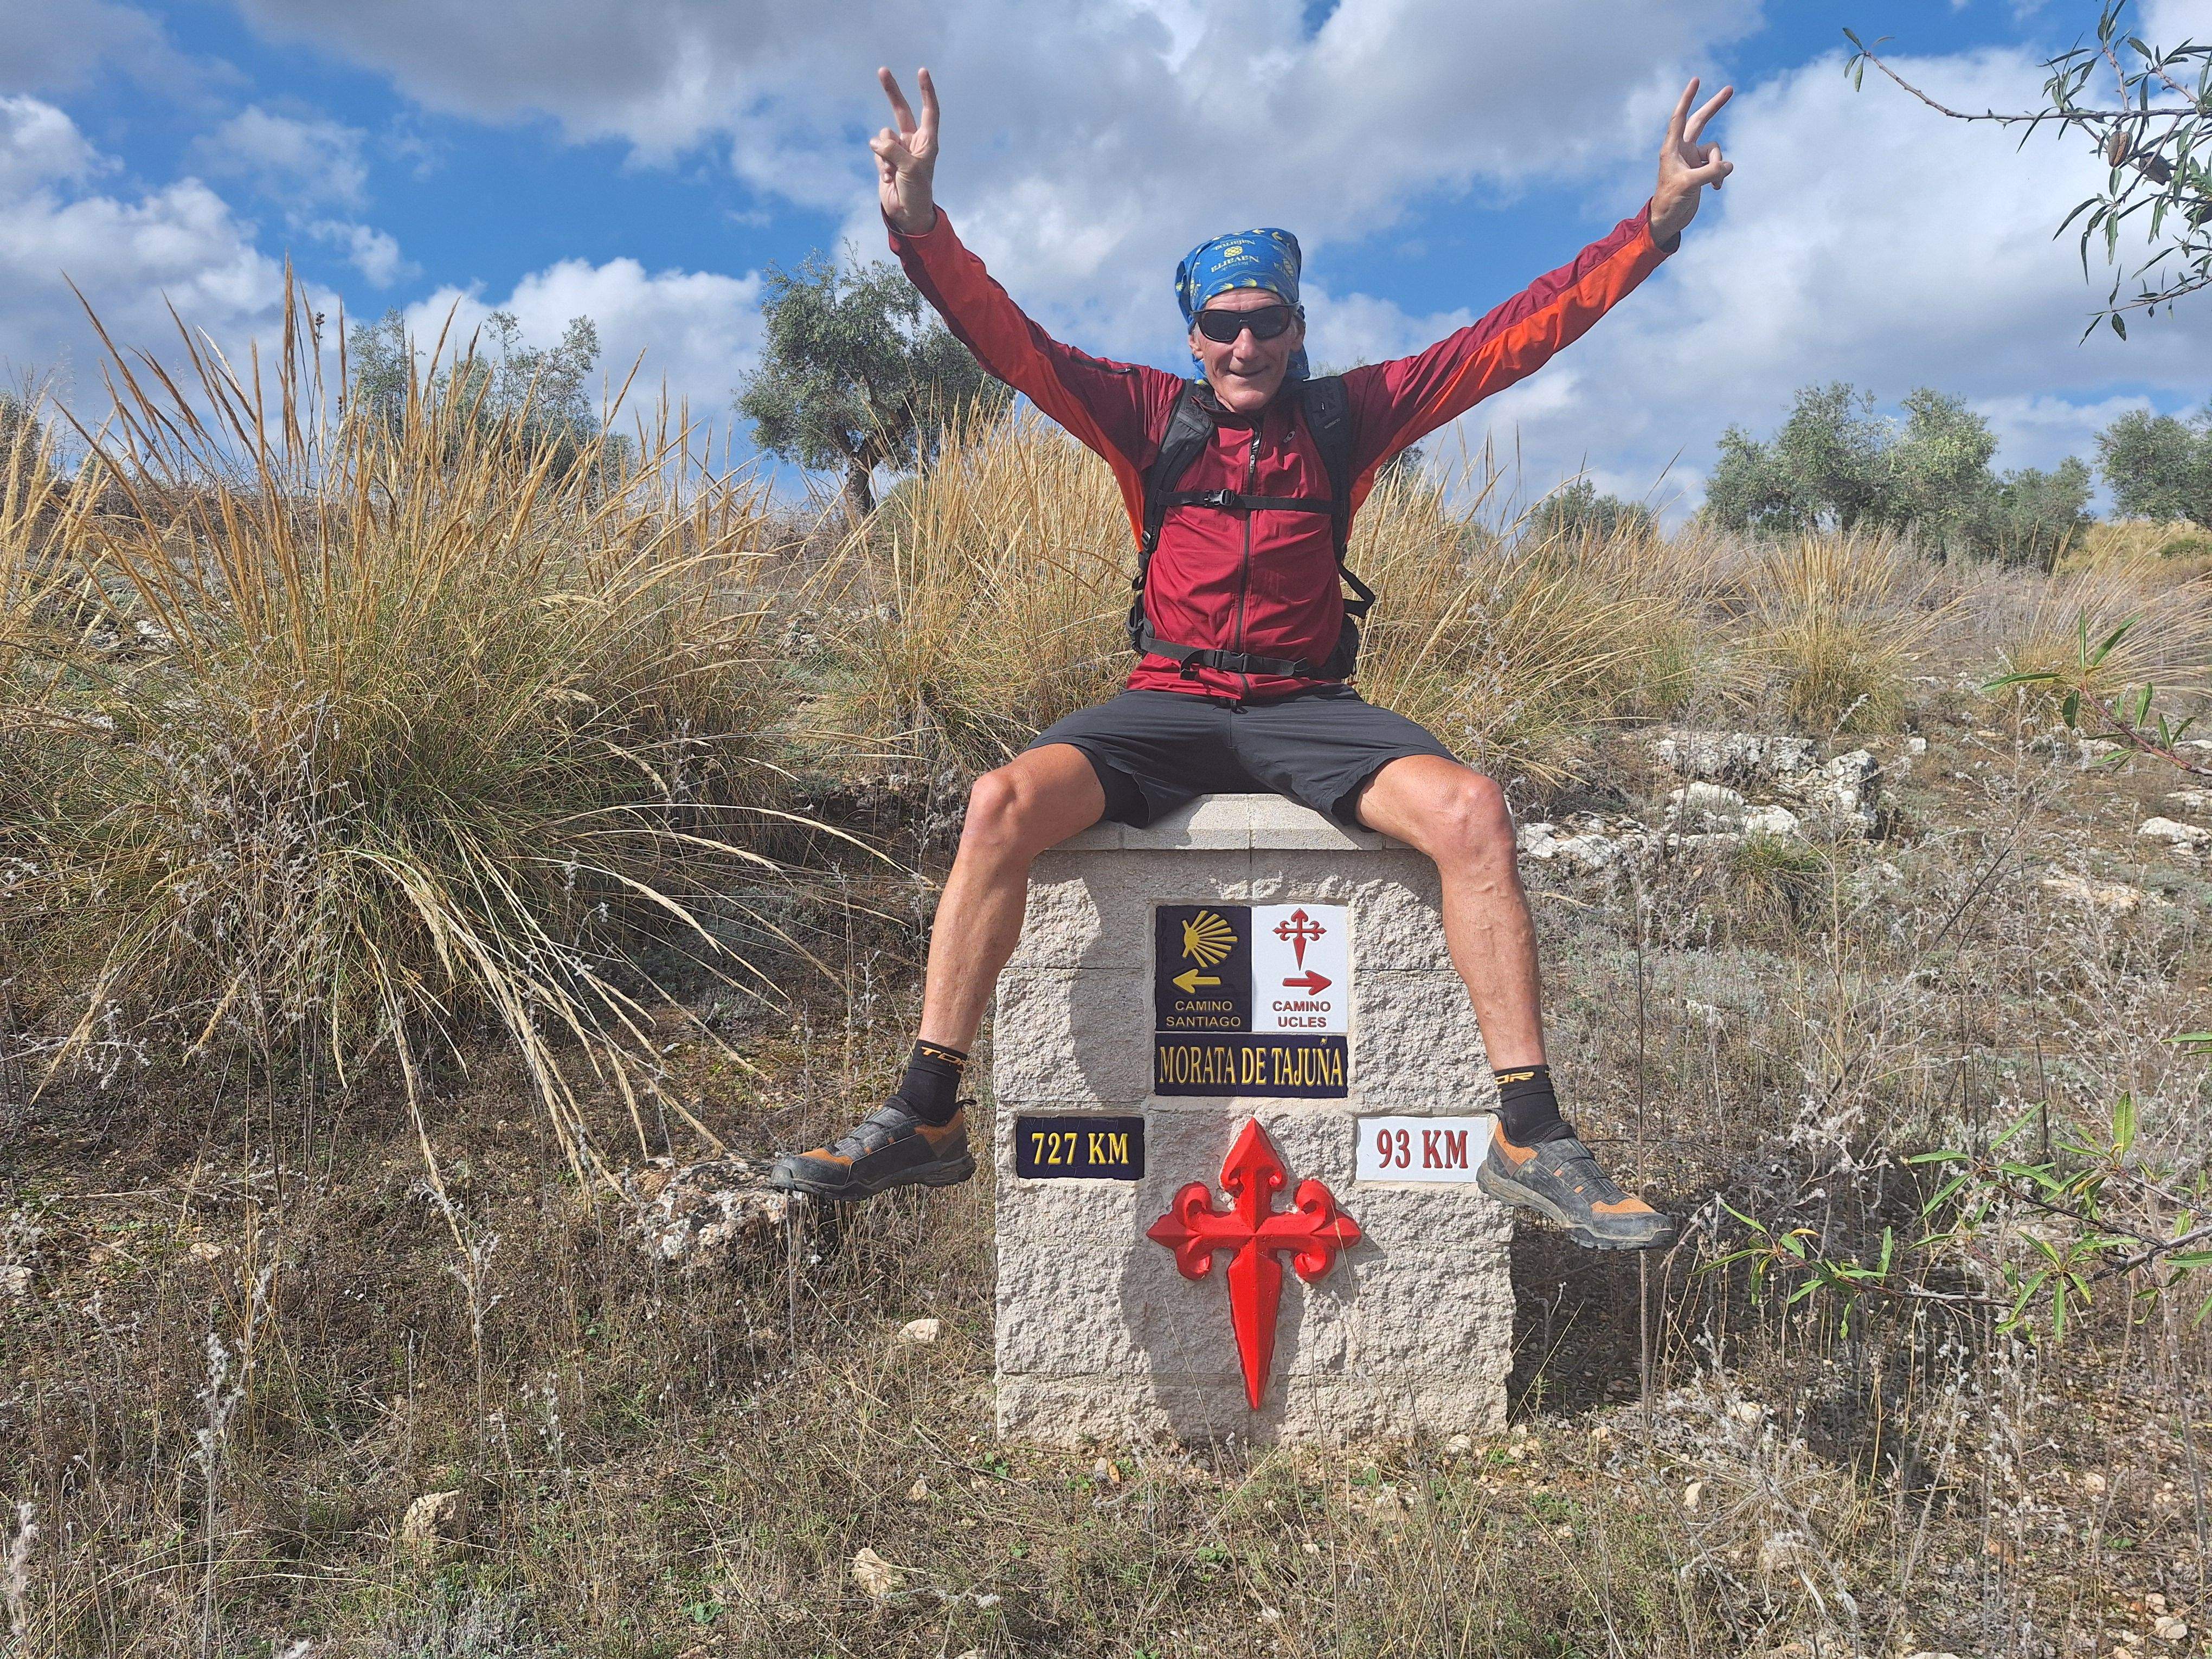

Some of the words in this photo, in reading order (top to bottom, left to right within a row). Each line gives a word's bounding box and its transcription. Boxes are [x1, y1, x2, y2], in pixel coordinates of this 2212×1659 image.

[1211, 255, 1259, 273] Navarra
[1175, 1000, 1232, 1011] CAMINO
[1272, 1000, 1331, 1012] CAMINO
[1166, 1016, 1241, 1027] SANTIAGO
[1278, 1016, 1327, 1028] UCLES
[1159, 1046, 1236, 1084] MORATA
[1242, 1047, 1267, 1084] DE
[1271, 1038, 1343, 1087] TAJUÑA
[1032, 1132, 1078, 1165] 727
[1088, 1132, 1129, 1165] KM
[1377, 1129, 1411, 1169] 93
[1422, 1130, 1469, 1169] KM
